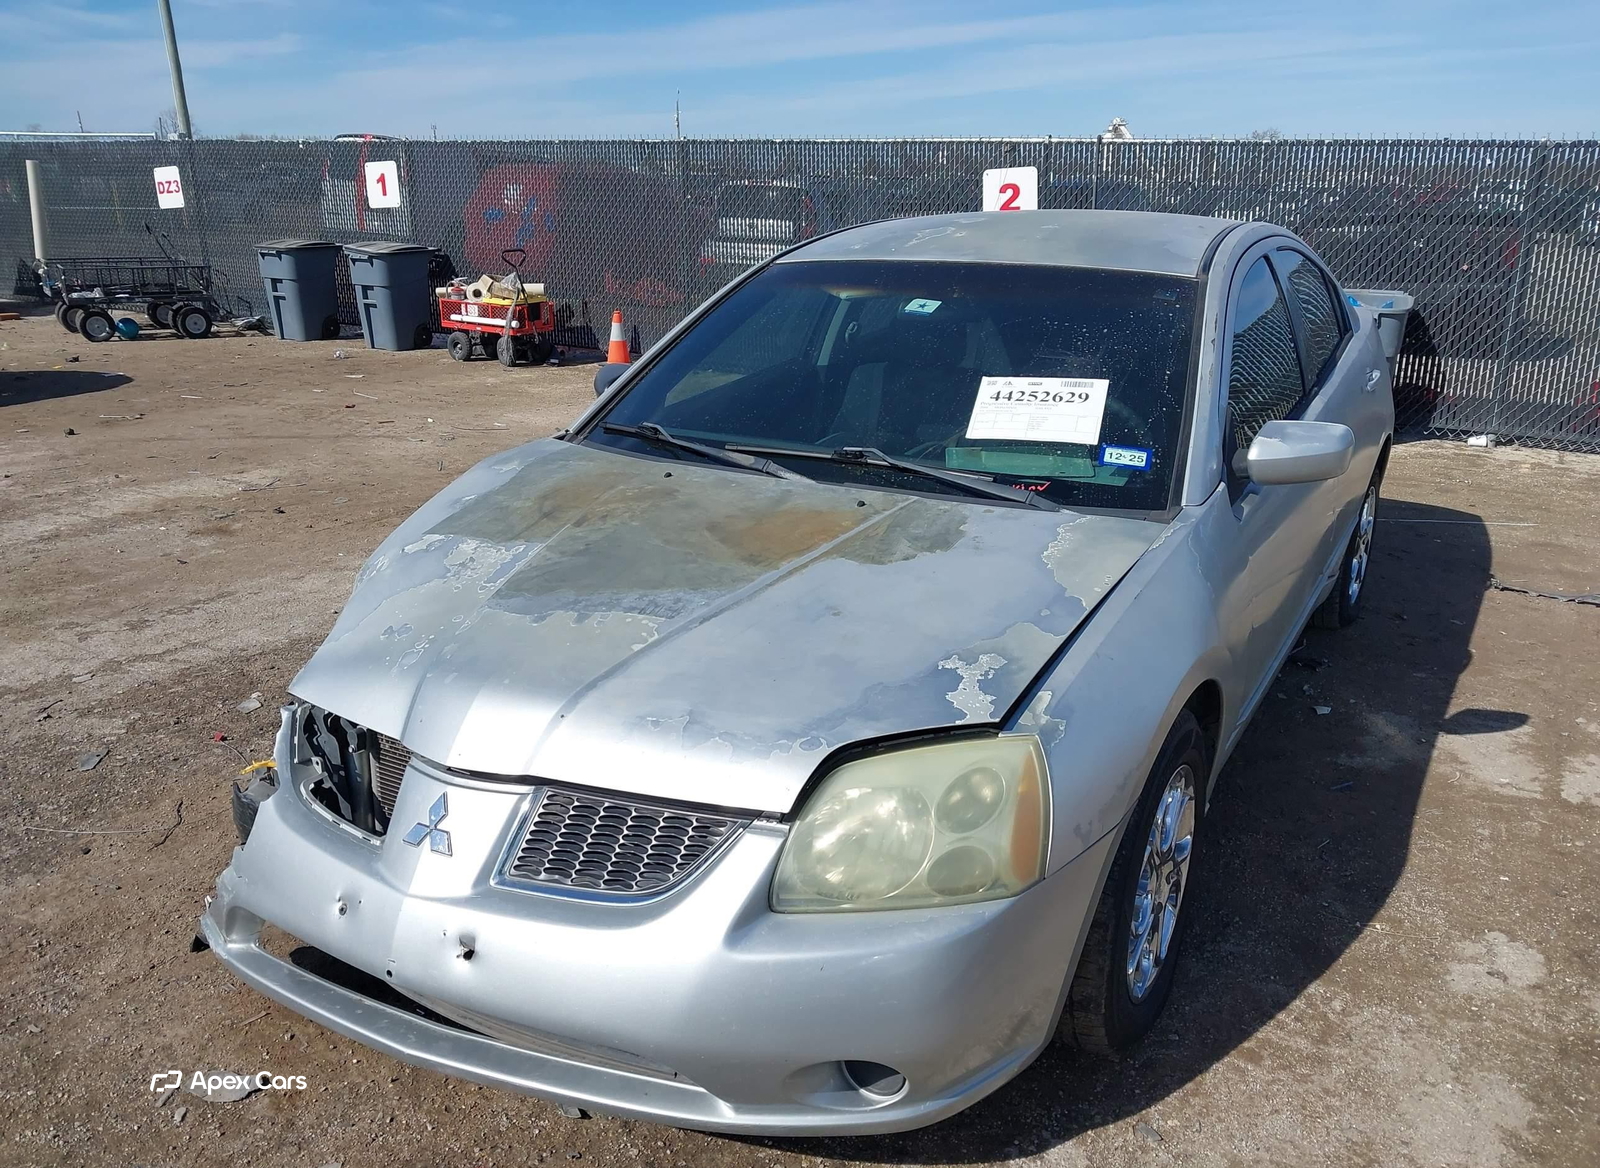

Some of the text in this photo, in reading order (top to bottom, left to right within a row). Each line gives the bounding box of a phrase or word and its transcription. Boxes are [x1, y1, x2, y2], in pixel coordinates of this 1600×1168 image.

[157, 180, 180, 194] DZ3
[376, 173, 387, 196] 1
[999, 183, 1020, 210] 2
[989, 390, 1090, 404] 44252629
[1108, 452, 1144, 463] 12 25
